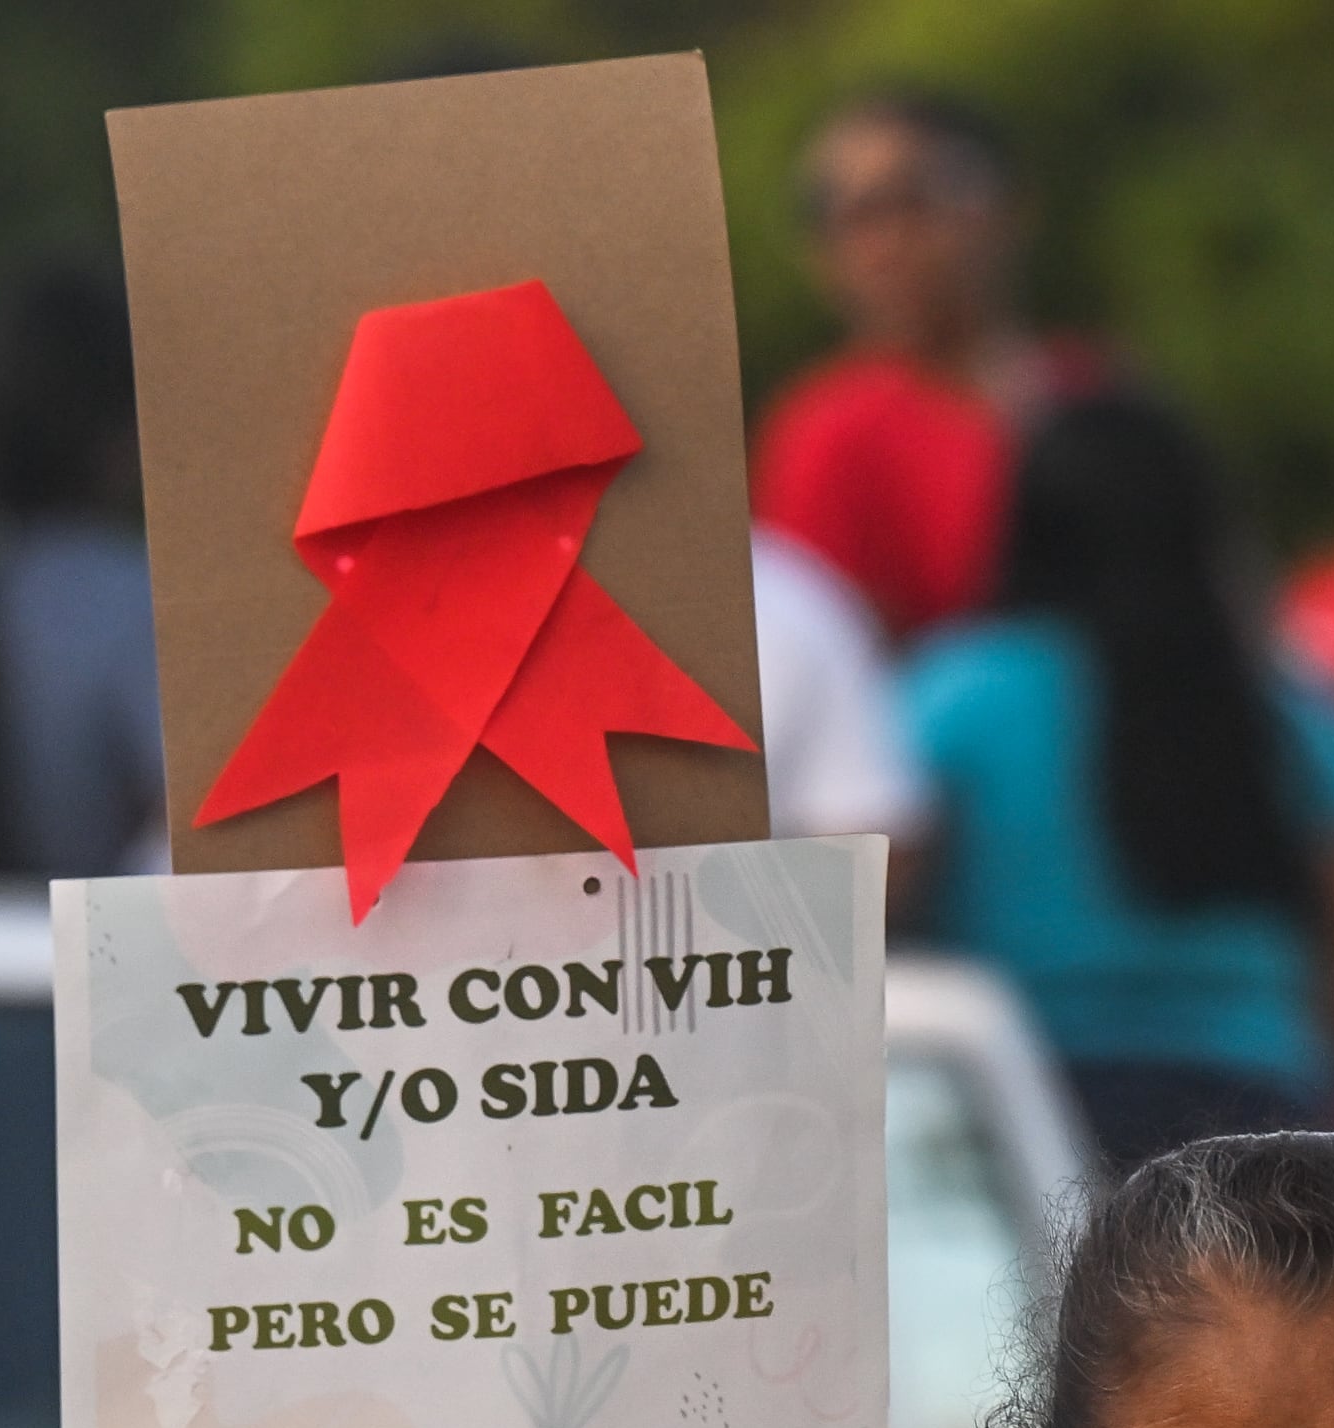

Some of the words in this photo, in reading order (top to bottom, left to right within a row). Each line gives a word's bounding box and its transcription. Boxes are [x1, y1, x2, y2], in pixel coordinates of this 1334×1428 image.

[176, 973, 426, 1037] VIVIR
[449, 961, 623, 1023] CON
[645, 949, 792, 1011] VIH
[301, 1069, 457, 1140] Y/O
[482, 1054, 679, 1119] SIDA
[235, 1206, 334, 1253] NO
[403, 1199, 487, 1244] ES
[539, 1181, 732, 1237] FACIL
[208, 1300, 393, 1350] PERO
[432, 1293, 515, 1339] SE
[550, 1272, 773, 1334] PUEDE
